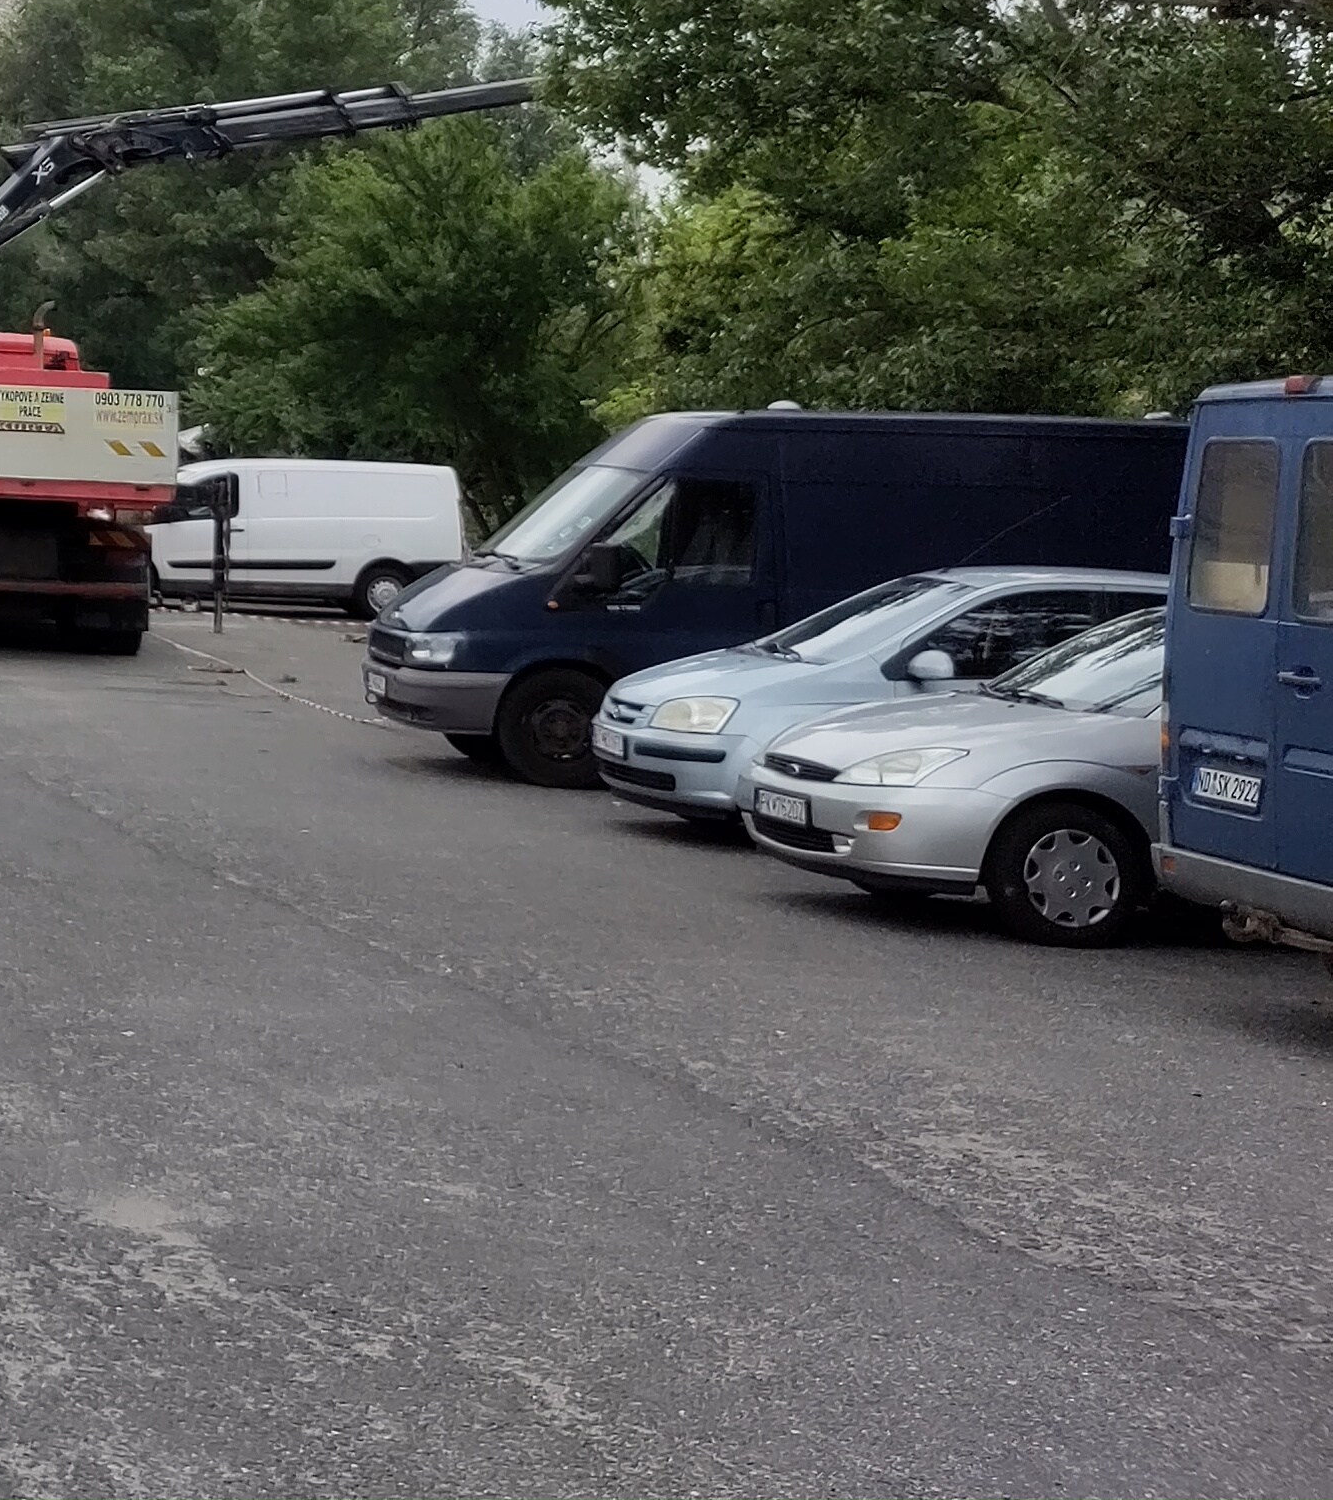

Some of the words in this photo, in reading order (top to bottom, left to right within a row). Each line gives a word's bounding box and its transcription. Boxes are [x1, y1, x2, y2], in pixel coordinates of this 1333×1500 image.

[95, 392, 120, 406] 0903
[123, 393, 142, 407] 778
[145, 394, 164, 408] 770
